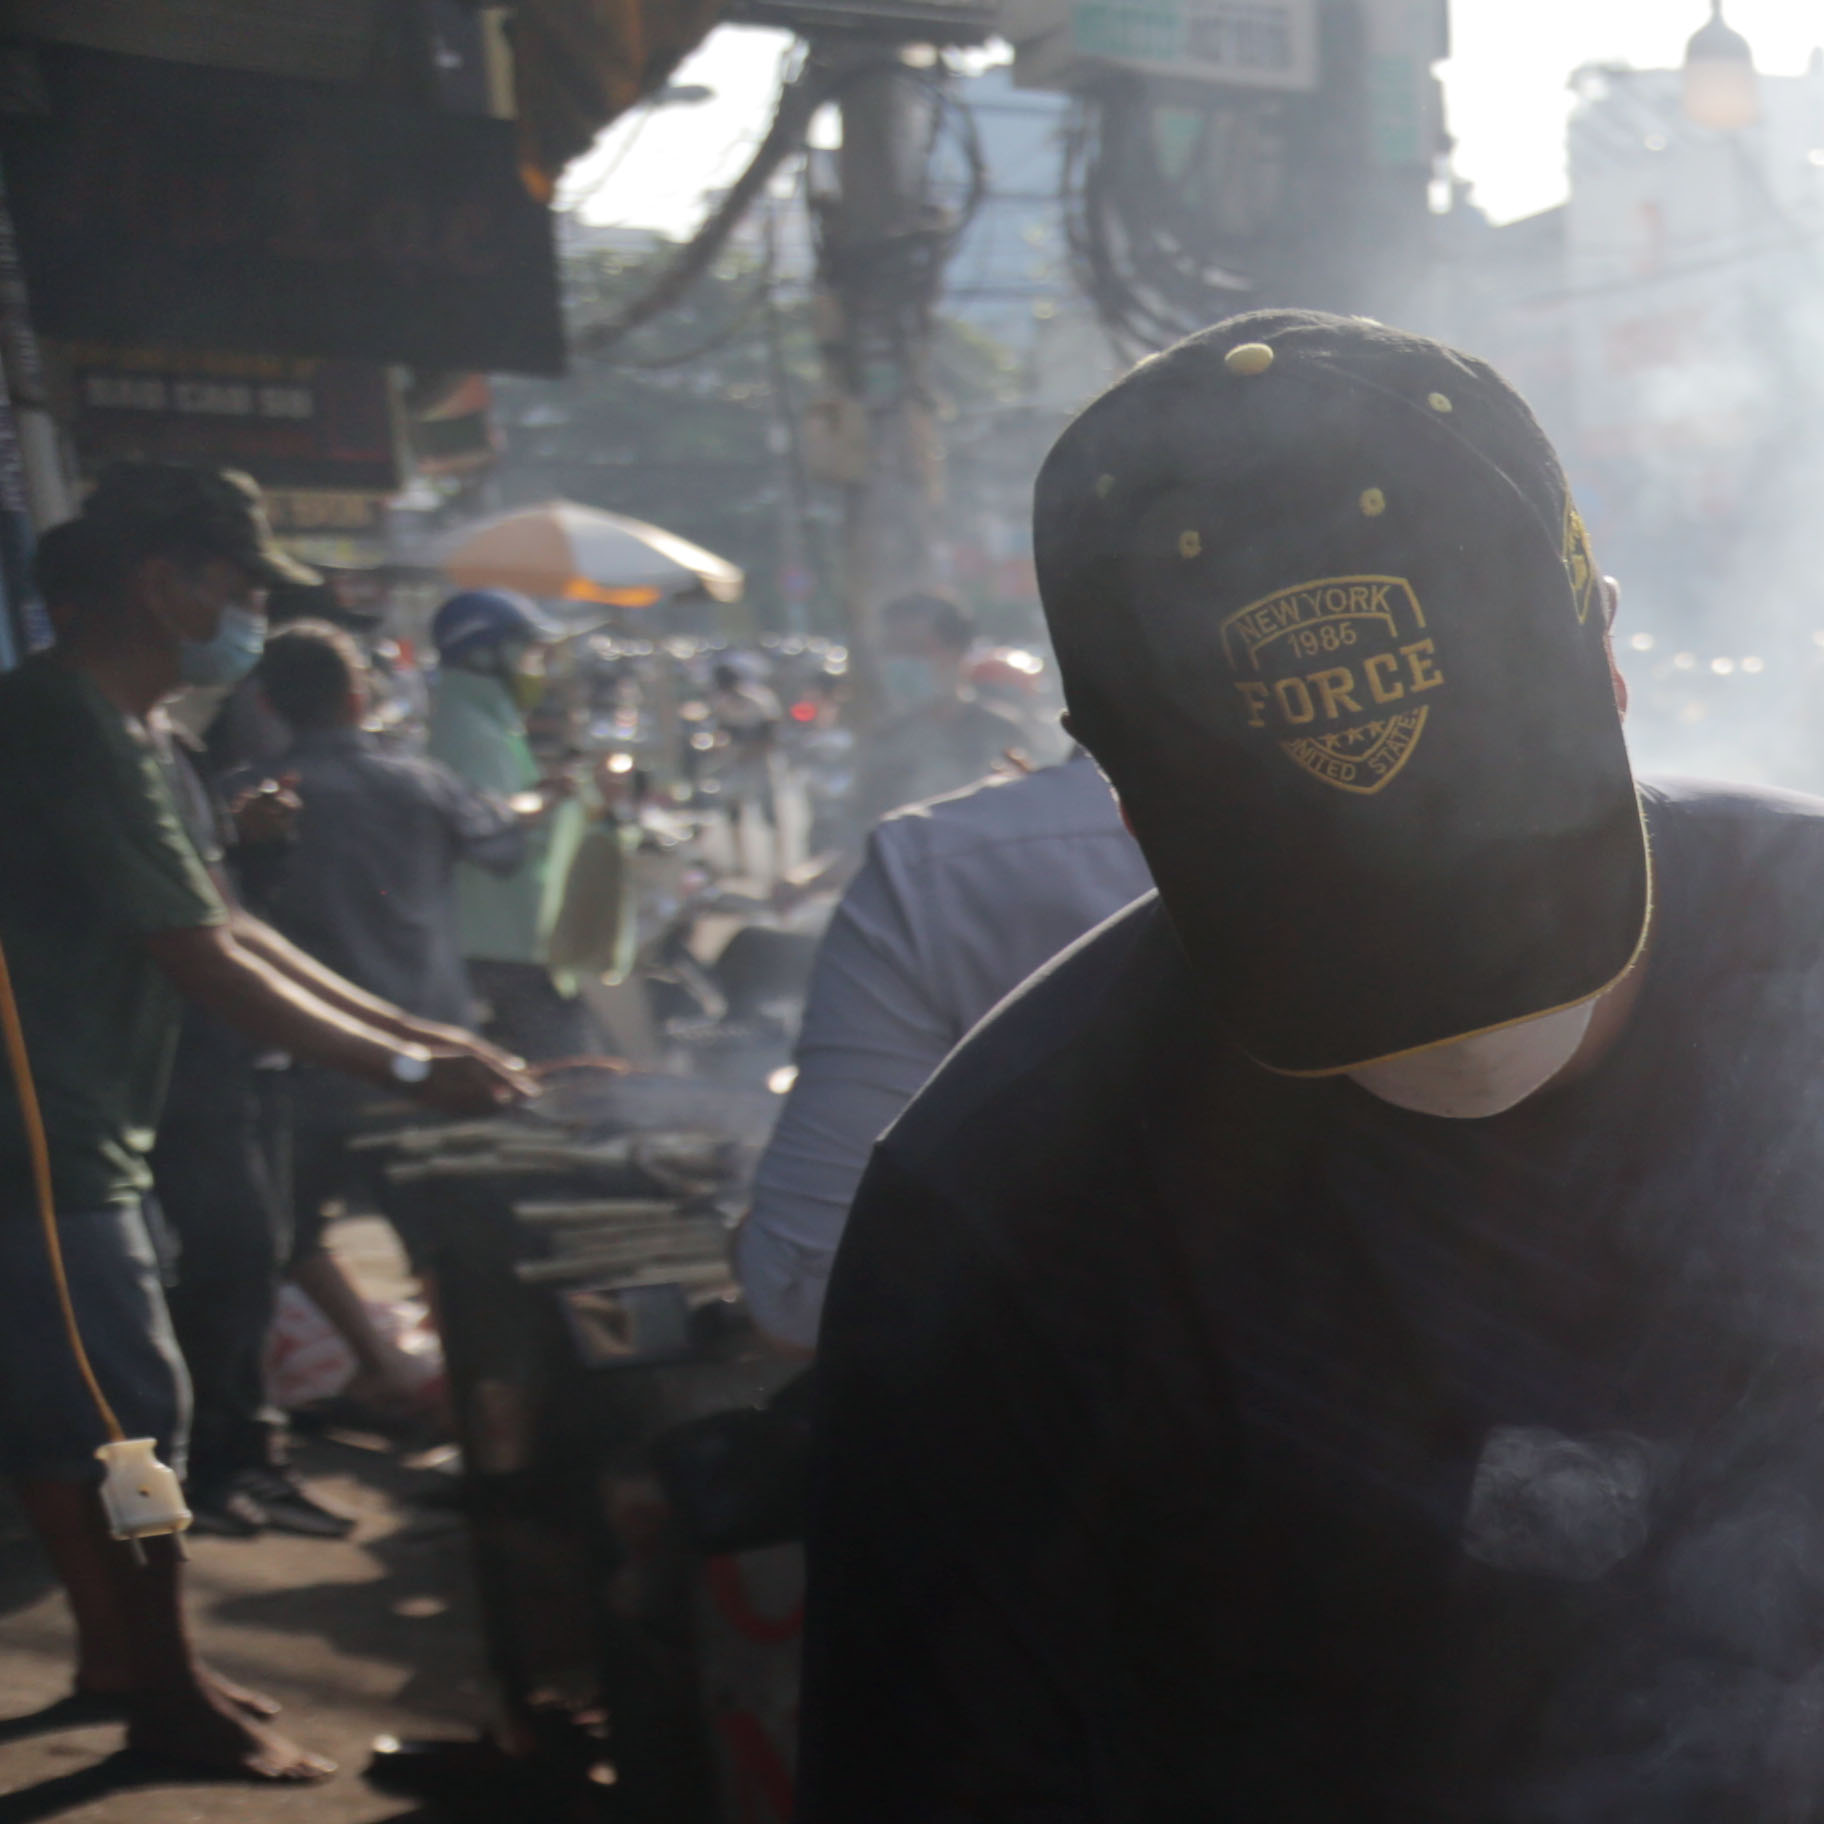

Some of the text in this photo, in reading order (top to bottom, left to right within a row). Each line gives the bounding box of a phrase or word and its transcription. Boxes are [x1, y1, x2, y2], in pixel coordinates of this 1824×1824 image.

[1235, 583, 1394, 644] NEW YORK
[1232, 636, 1446, 729] FORCE
